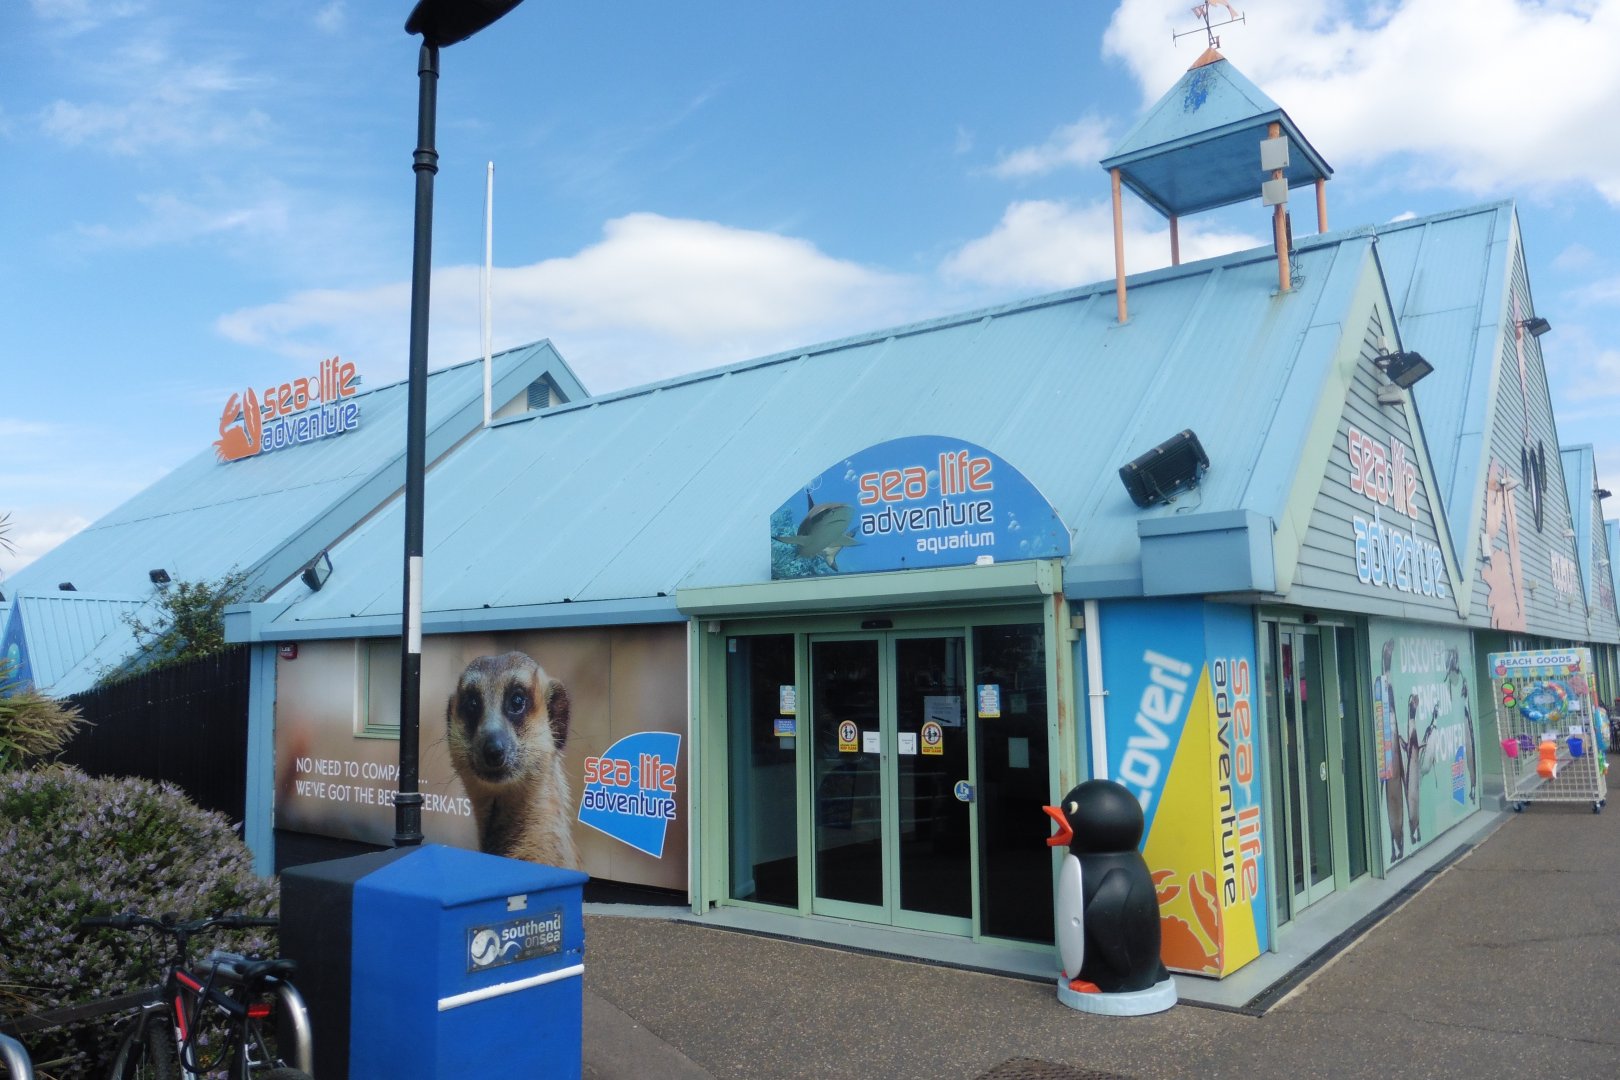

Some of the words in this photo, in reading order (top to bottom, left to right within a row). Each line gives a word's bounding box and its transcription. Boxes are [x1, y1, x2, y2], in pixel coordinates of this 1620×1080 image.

[263, 378, 309, 420] sea
[319, 356, 356, 402] life
[263, 402, 358, 450] adventure
[859, 466, 926, 505] sea
[938, 450, 993, 496] life
[1348, 426, 1389, 505] sea
[1390, 435, 1417, 520] life
[860, 499, 993, 536] adventure
[916, 530, 995, 554] aquarium
[1353, 504, 1445, 599] adventure
[1400, 638, 1447, 674] DISCOVER
[1500, 658, 1532, 666] BEACH
[1536, 655, 1572, 664] GOODS
[1231, 657, 1255, 788] sea
[296, 757, 312, 773] NO
[315, 759, 341, 776] NEED
[344, 762, 359, 778] TO
[584, 756, 631, 787] sea
[639, 753, 676, 791] life
[1213, 657, 1237, 907] adventure
[296, 781, 325, 798] WE'VE
[328, 784, 351, 801] GOT
[354, 787, 374, 804] THE
[377, 789, 400, 807] BES
[584, 786, 676, 819] adventure
[1238, 805, 1262, 901] life
[502, 915, 561, 941] southend
